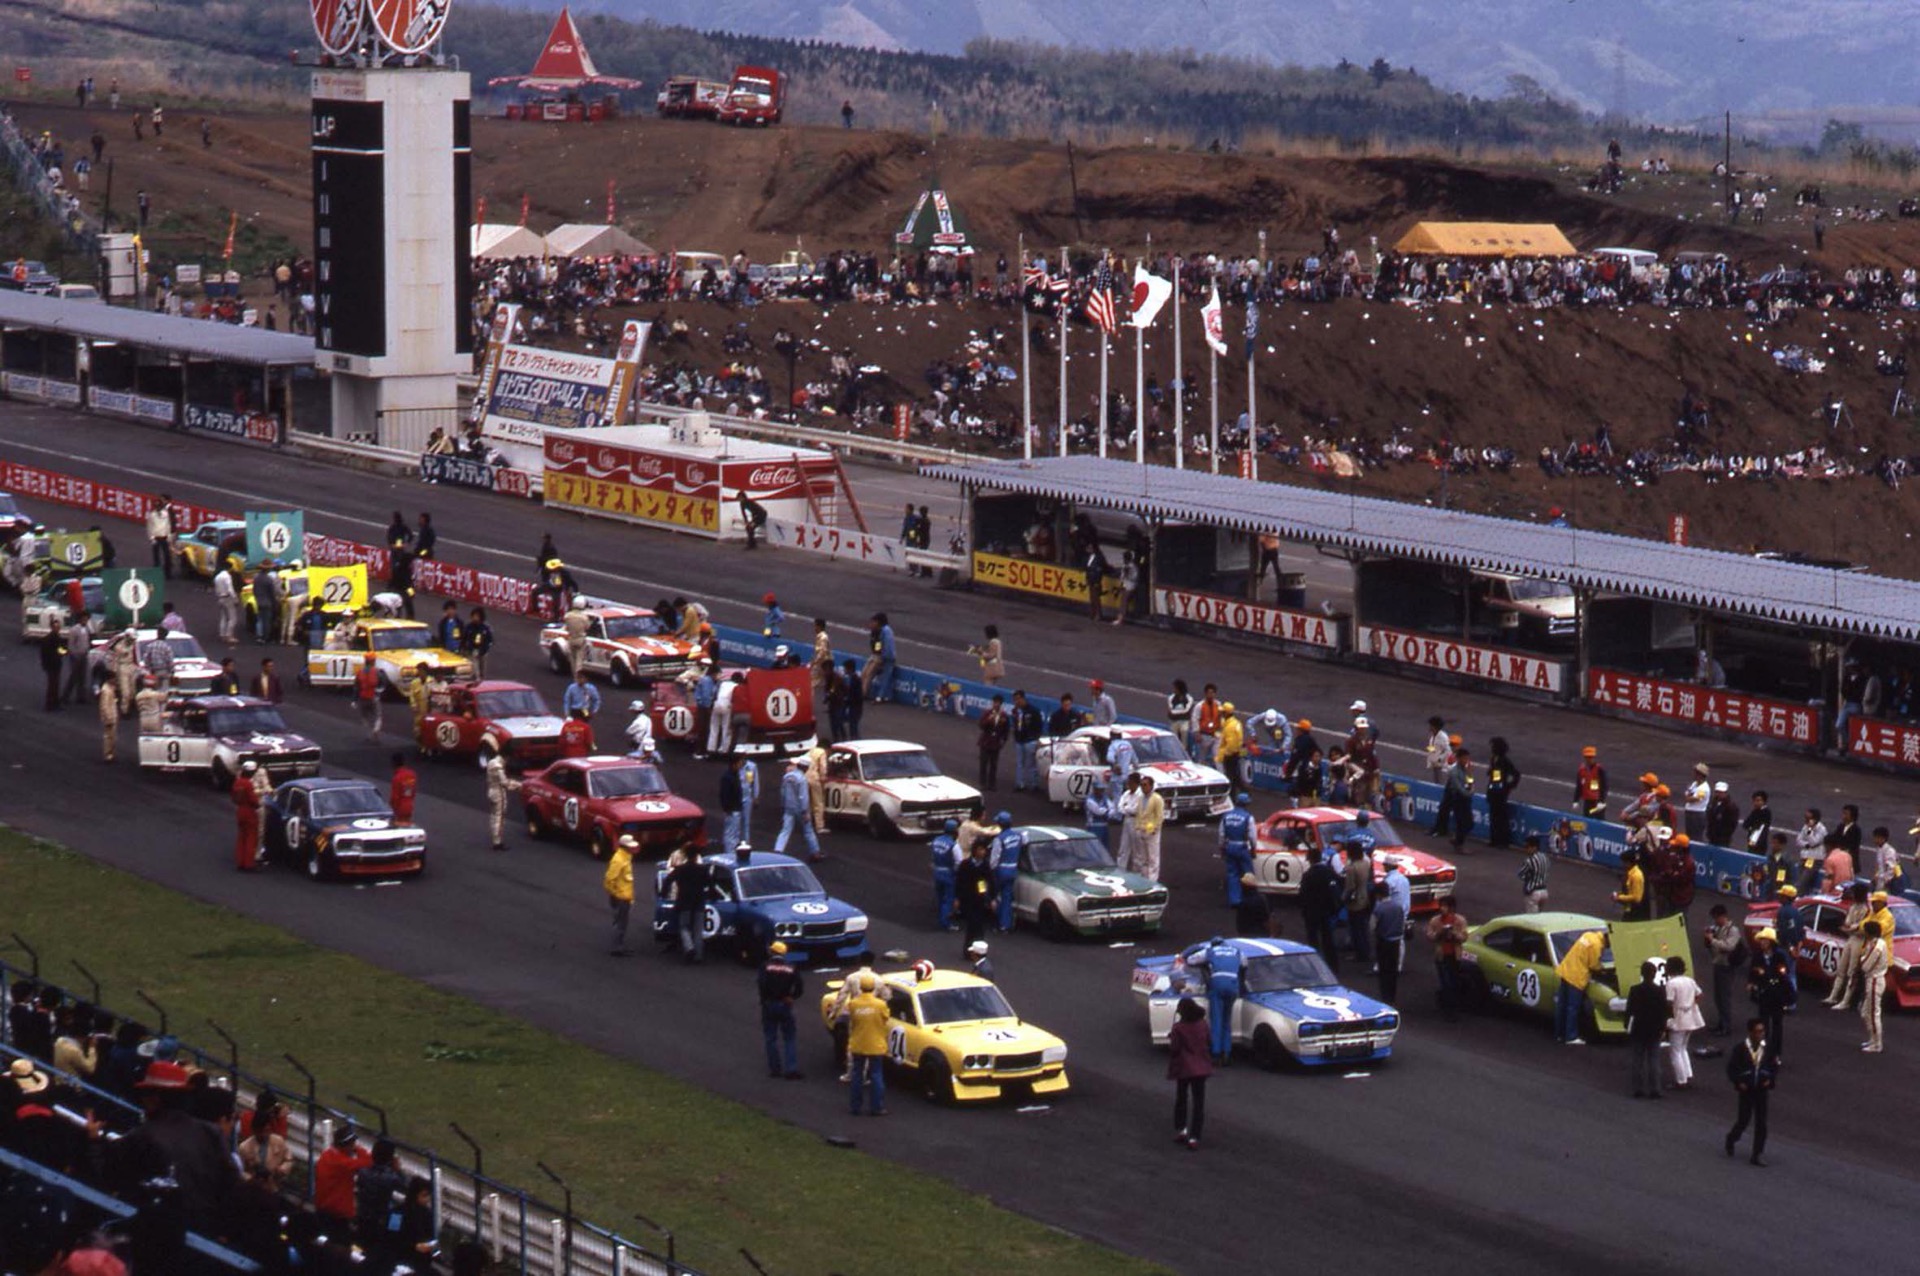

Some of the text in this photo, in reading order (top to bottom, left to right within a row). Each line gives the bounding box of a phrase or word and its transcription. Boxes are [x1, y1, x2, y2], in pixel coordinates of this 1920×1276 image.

[750, 467, 797, 485] Coca-Cola
[266, 528, 286, 549] 14
[795, 525, 873, 558] オンワード
[70, 544, 83, 564] 19
[477, 571, 517, 600] TUDOR
[977, 560, 1005, 578] ミクニ
[1008, 561, 1065, 594] SOLEX
[325, 581, 352, 603] 22
[1177, 593, 1328, 644] YOKOHAMA
[332, 658, 348, 678] 17
[1384, 632, 1550, 689] YOKOHAMA
[771, 696, 791, 717] 31
[1616, 677, 1810, 741] 三菱石油 三菱石油
[668, 710, 686, 731] 31
[439, 722, 458, 744] 30
[1074, 774, 1093, 796] 27
[1275, 860, 1290, 883] 6
[704, 908, 714, 932] 6
[1822, 945, 1838, 972] 25
[1520, 972, 1537, 1000] 23
[891, 1030, 905, 1058] 24
